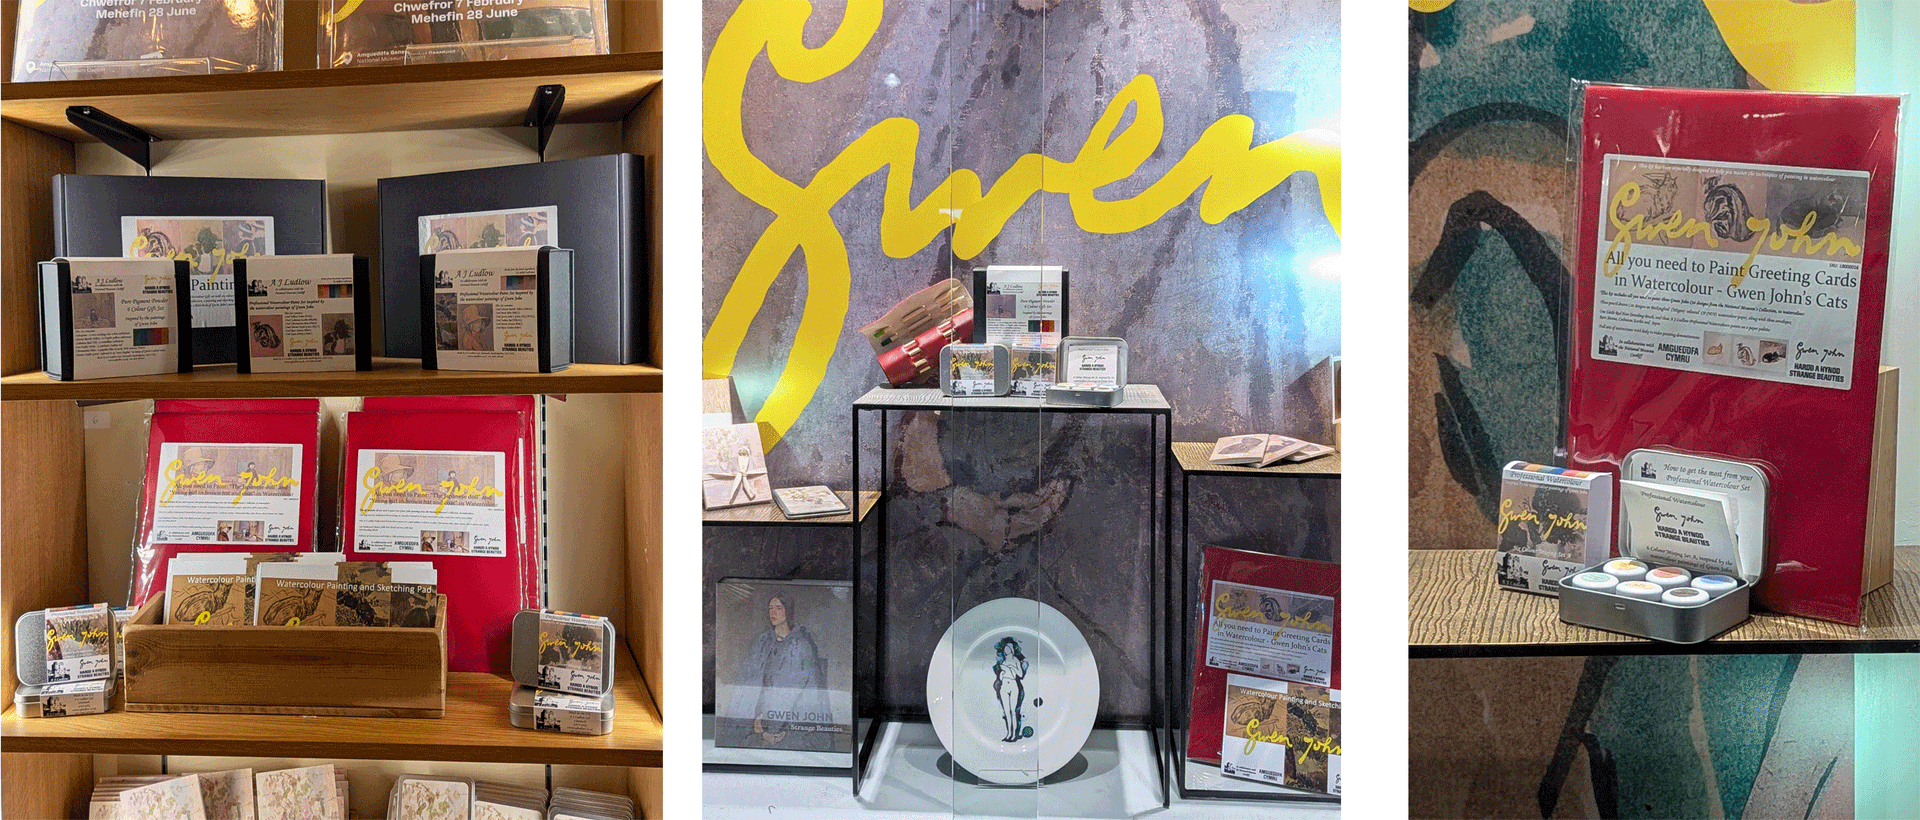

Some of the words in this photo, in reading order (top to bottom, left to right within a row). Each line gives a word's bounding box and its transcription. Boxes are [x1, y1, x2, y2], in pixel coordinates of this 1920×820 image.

[96, 8, 146, 19] Mehefin
[149, 8, 164, 17] 28
[167, 7, 196, 17] June
[394, 0, 453, 12] Chwefror
[456, 0, 462, 8] 7
[412, 11, 463, 24] Mehefin
[467, 10, 483, 19] 28
[486, 9, 518, 19] June
[1603, 181, 1718, 278] Gwen
[1731, 210, 1861, 287] John
[455, 270, 461, 278] A
[462, 270, 467, 278] J
[1605, 251, 1624, 265] All
[1627, 256, 1651, 270] you
[1656, 257, 1688, 272] need
[1691, 260, 1705, 273] to
[1709, 260, 1745, 277] Paint
[1749, 264, 1811, 288] Greeting
[1815, 270, 1857, 288] Cards
[269, 279, 276, 287] A
[278, 279, 283, 287] J
[284, 278, 312, 286] Ludlow
[1614, 272, 1627, 287] in
[1631, 274, 1714, 296] Watercolour
[1726, 284, 1765, 301] Gwen
[1768, 288, 1812, 306] John's
[1816, 292, 1848, 309] Cats
[1658, 343, 1699, 356] AMGUEDDFA
[1665, 353, 1690, 363] CYMRU
[1795, 341, 1819, 360] Gwen
[1820, 347, 1845, 363] John
[1789, 370, 1816, 379] STRANGE
[1816, 373, 1845, 383] BEAUTIES
[1794, 363, 1814, 371] HARDD
[1820, 366, 1841, 374] HYNOD
[1666, 474, 1702, 485] Professional
[1703, 478, 1739, 490] Watercolour
[1687, 467, 1697, 475] get
[1709, 469, 1722, 477] most
[1722, 470, 1738, 480] from
[160, 459, 225, 506] Gwen
[232, 467, 299, 506] John
[360, 466, 426, 515] Gwen
[435, 476, 503, 515] John
[1640, 490, 1672, 502] Professional
[1672, 497, 1706, 507] Watercolour
[1498, 499, 1540, 534] Gwen
[1543, 512, 1587, 541] John
[1654, 506, 1677, 523] Gwen
[1680, 515, 1704, 527] John
[1654, 530, 1681, 541] STRANGE
[1681, 536, 1710, 547] BEAUTIES
[1541, 559, 1561, 576] Gwen
[1563, 566, 1577, 577] Joh
[187, 576, 234, 584] Watercolour
[276, 580, 324, 589] Watercolour
[327, 582, 357, 592] Painting
[360, 583, 374, 591] and
[377, 584, 414, 594] Sketching
[417, 585, 432, 594] Pad
[1539, 584, 1559, 593] STRANG
[1212, 592, 1267, 632] Gwen
[1272, 611, 1332, 640] John
[47, 629, 75, 651] Gwen
[80, 628, 108, 647] John
[1213, 619, 1222, 628] All
[1223, 622, 1236, 631] you
[1237, 623, 1253, 633] need
[1254, 626, 1261, 634] to
[1262, 628, 1280, 637] Paint
[1281, 631, 1310, 644] Greeting
[1311, 635, 1331, 645] Cards
[539, 631, 568, 653] Gwen
[571, 640, 602, 658] John
[1225, 631, 1265, 644] Watercolour
[1271, 638, 1290, 648] Gwen
[1291, 641, 1311, 652] John's
[1312, 645, 1328, 654] Cats
[1240, 688, 1278, 699] Watercolour
[1279, 694, 1303, 704] Painting
[1304, 698, 1317, 706] and
[767, 710, 799, 720] GWEN
[803, 712, 833, 721] JOHN
[790, 724, 816, 732] Strange
[1244, 718, 1293, 756] Gwen
